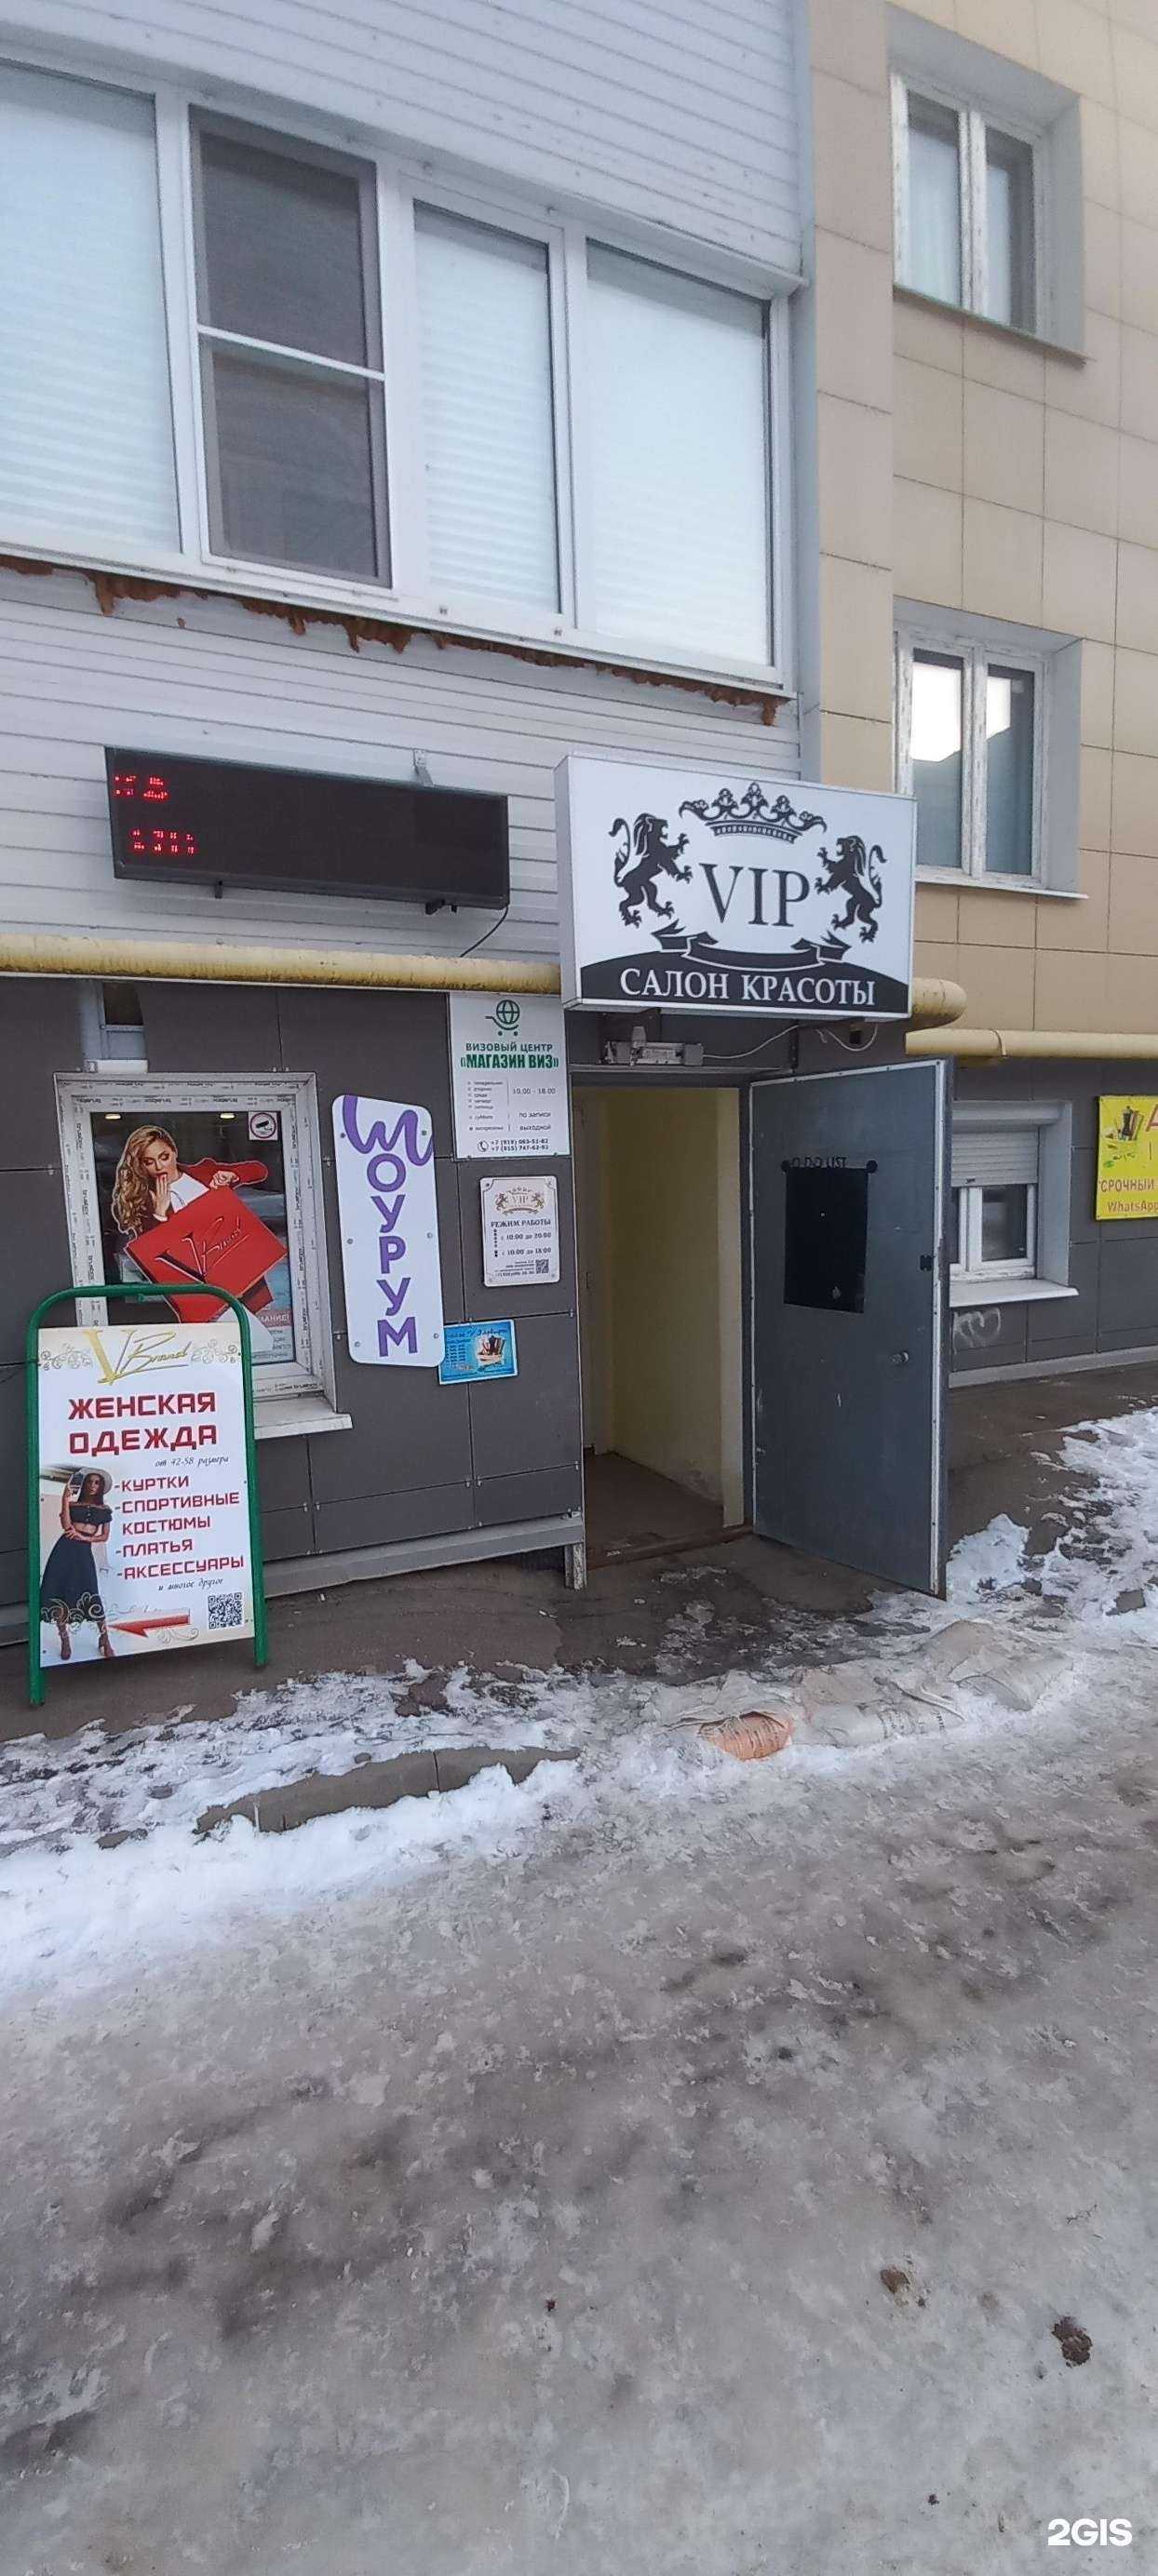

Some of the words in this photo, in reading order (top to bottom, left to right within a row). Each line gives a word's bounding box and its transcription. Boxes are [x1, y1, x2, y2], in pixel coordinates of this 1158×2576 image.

[698, 863, 811, 927] VIP
[620, 968, 729, 1000] САЛОН
[742, 974, 876, 1006] КРАСОТЫ
[461, 1053, 526, 1069] «МАГАЗИН
[529, 1053, 559, 1069] ВИЗ»
[465, 1041, 518, 1052] ВИЗОВЫЙ
[520, 1043, 553, 1053] ЦЕНТР
[342, 1094, 433, 1358] ШОУРУМ
[68, 1392, 216, 1420] ЖЕНСКАЯ
[69, 1425, 217, 1456] ОДЕЖДА
[122, 1516, 210, 1536] КОСТЮМЫ
